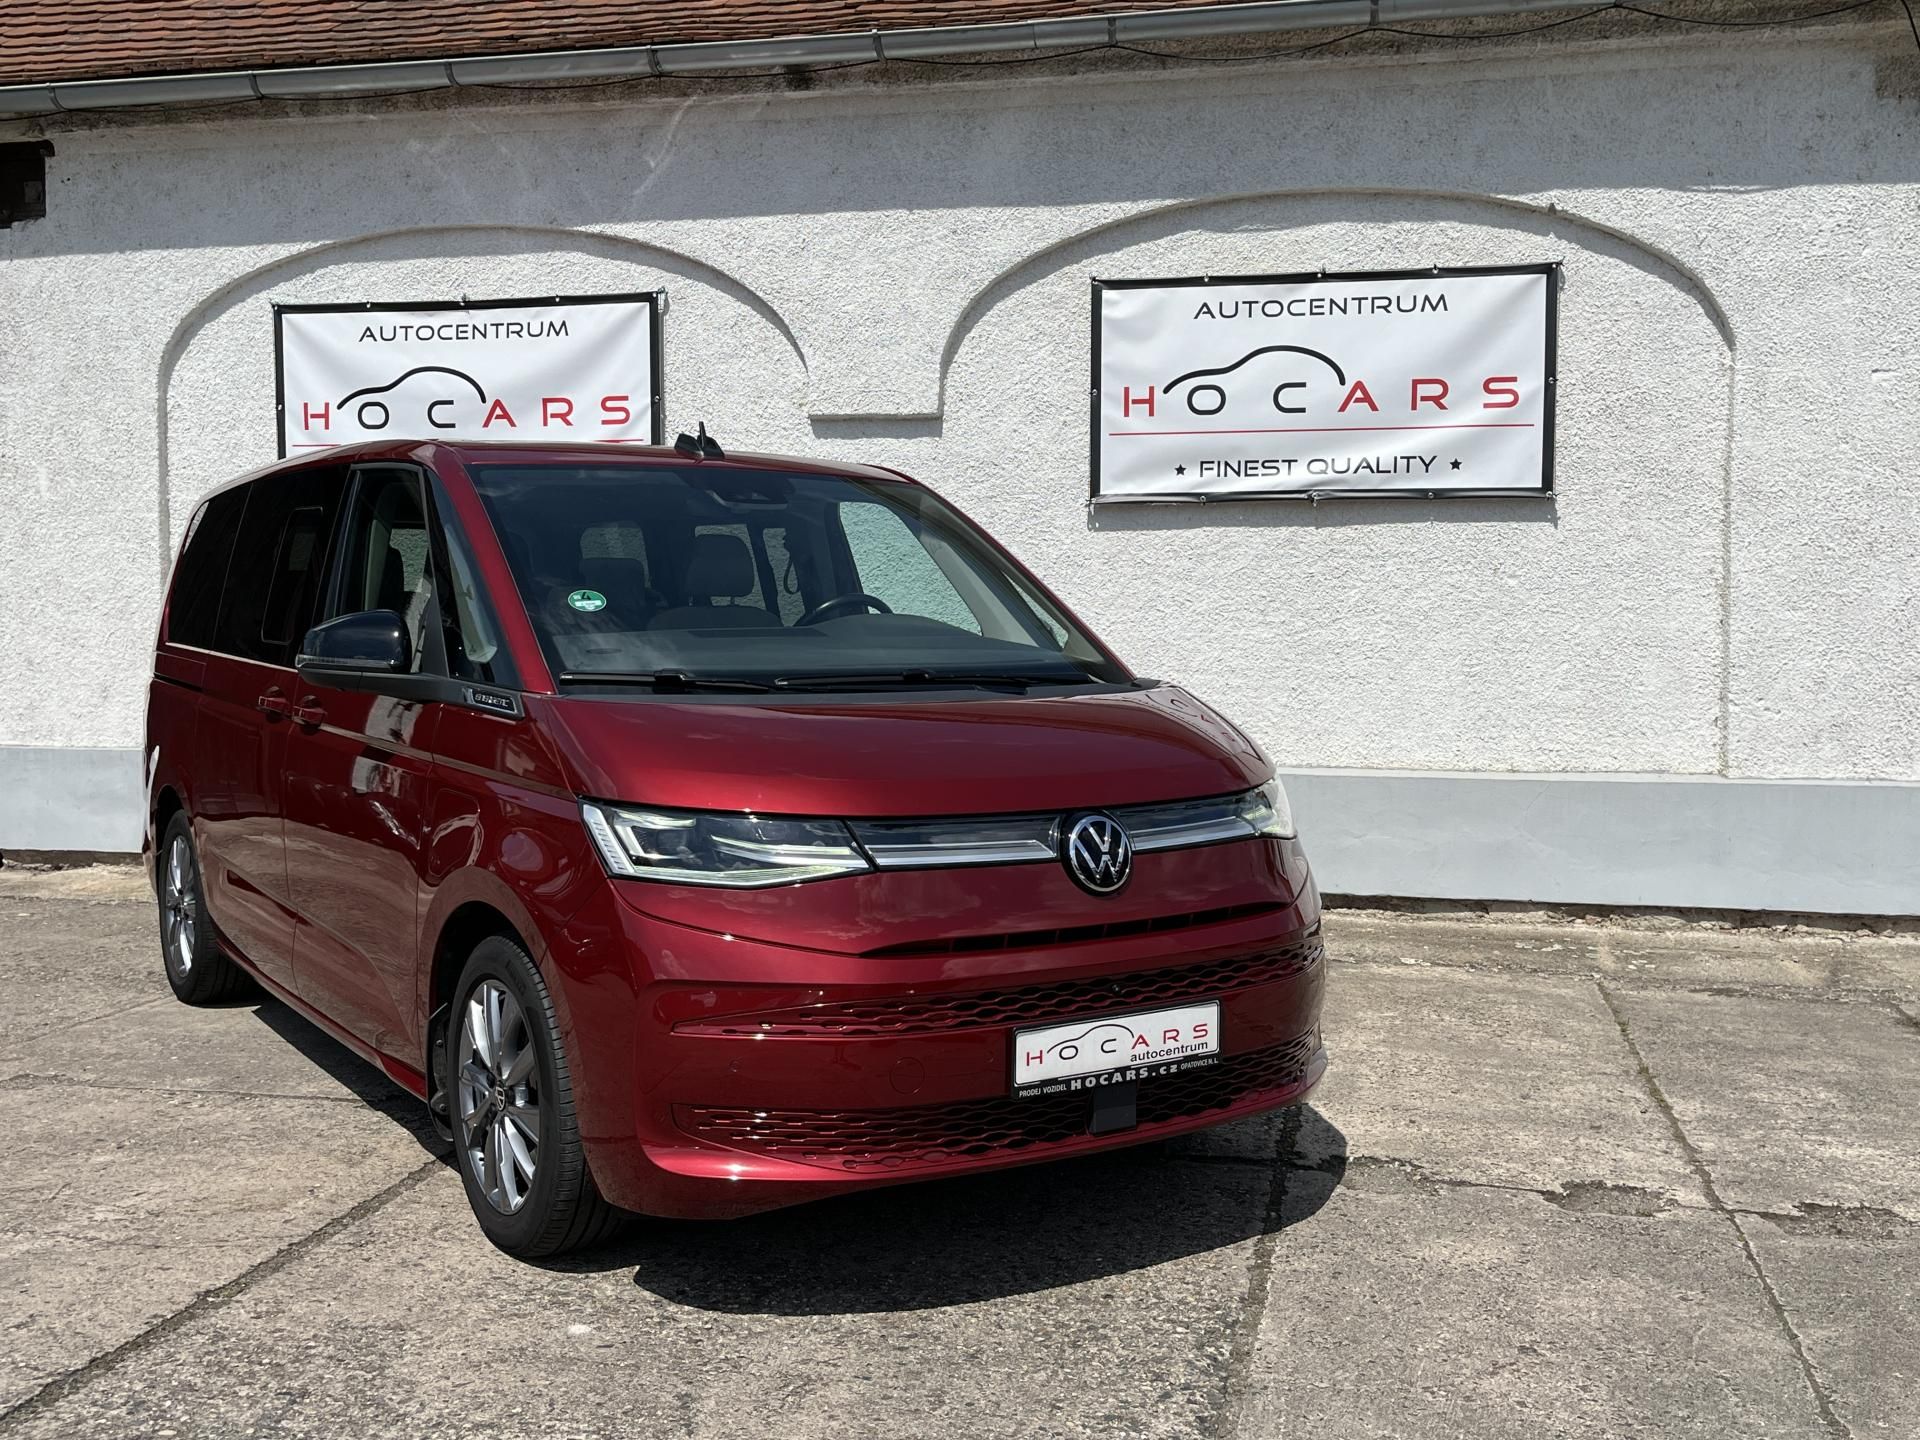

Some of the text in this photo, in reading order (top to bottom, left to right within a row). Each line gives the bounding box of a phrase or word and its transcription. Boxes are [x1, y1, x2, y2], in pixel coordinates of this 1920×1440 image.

[1193, 293, 1449, 320] AUTOCENTRUM
[358, 319, 570, 343] AUTOCENTRUM
[1199, 455, 1438, 478] FINEST QUALITY
[1130, 1041, 1209, 1062] autocentrum
[1018, 1087, 1041, 1098] PRODEJ
[1043, 1083, 1067, 1094] VOZIDEL
